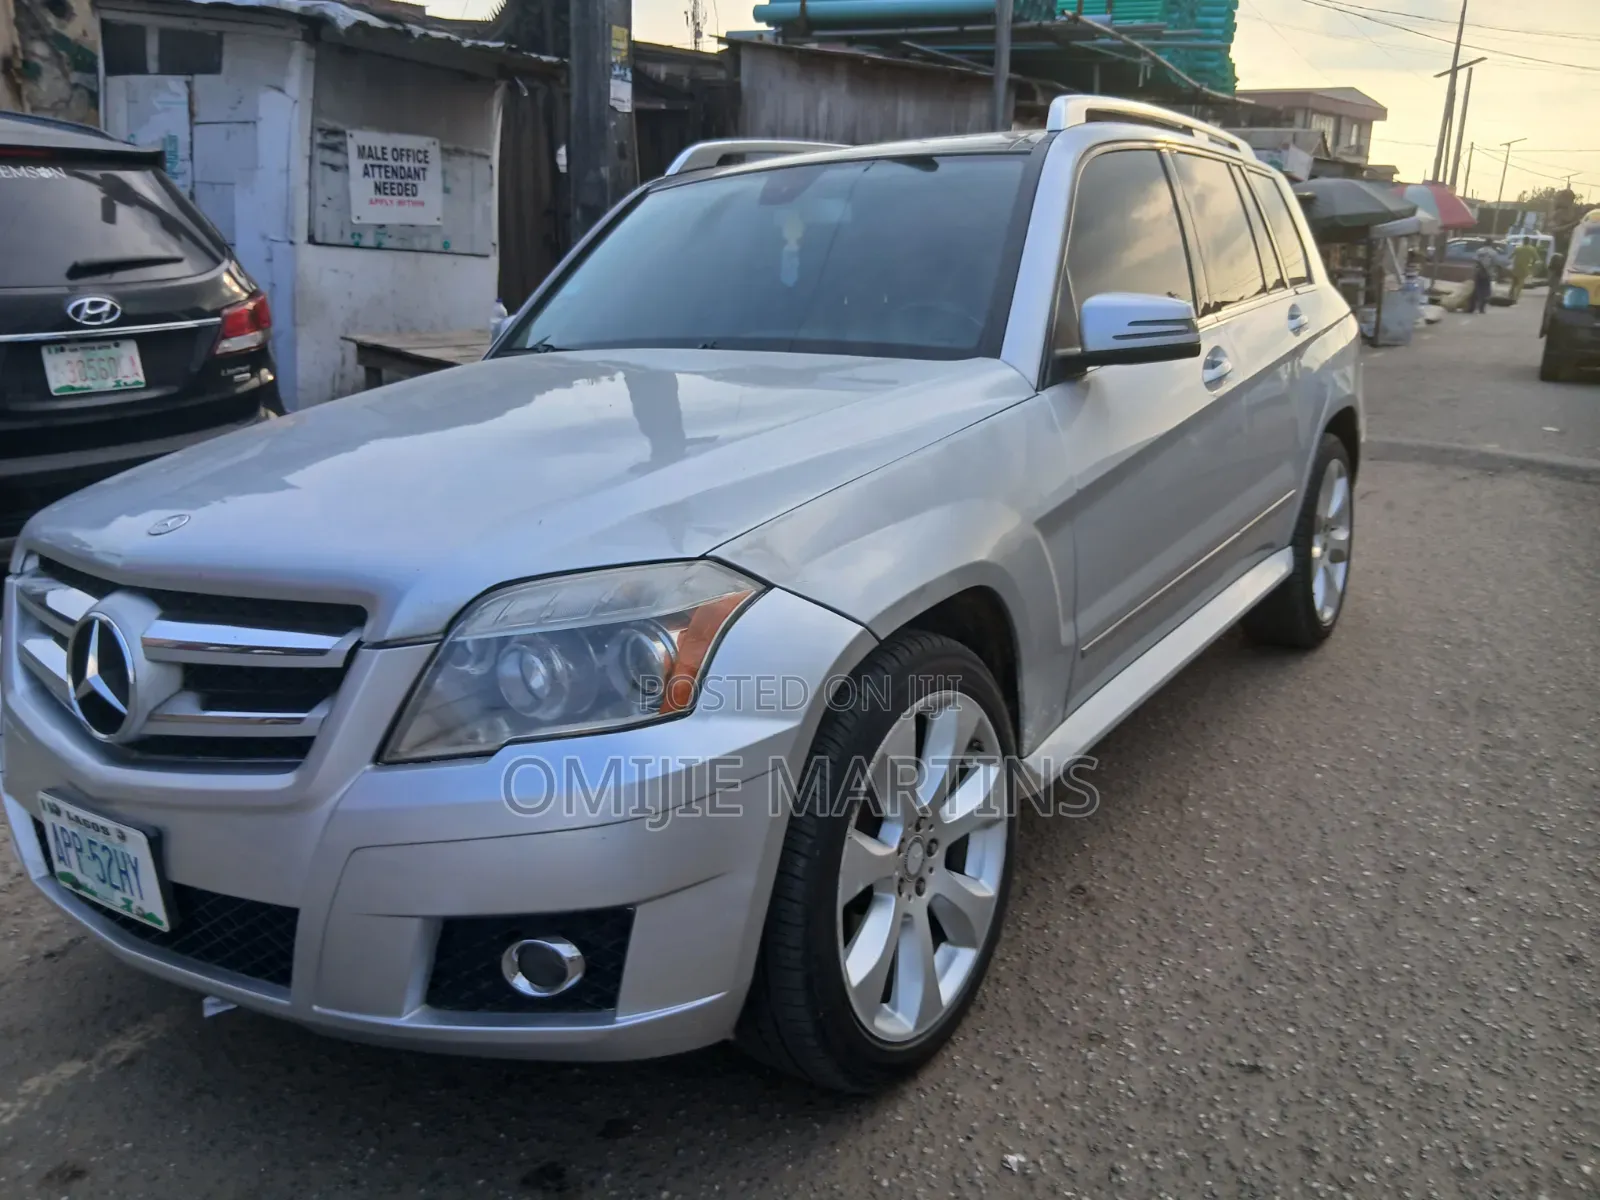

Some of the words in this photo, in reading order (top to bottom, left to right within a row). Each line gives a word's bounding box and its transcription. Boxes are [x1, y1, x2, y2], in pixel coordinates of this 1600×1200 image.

[357, 145, 388, 161] MALE
[391, 147, 430, 164] OFFICE
[363, 163, 427, 181] ATTENDANT
[374, 181, 418, 197] NEEDED
[66, 811, 111, 836] LAGOS
